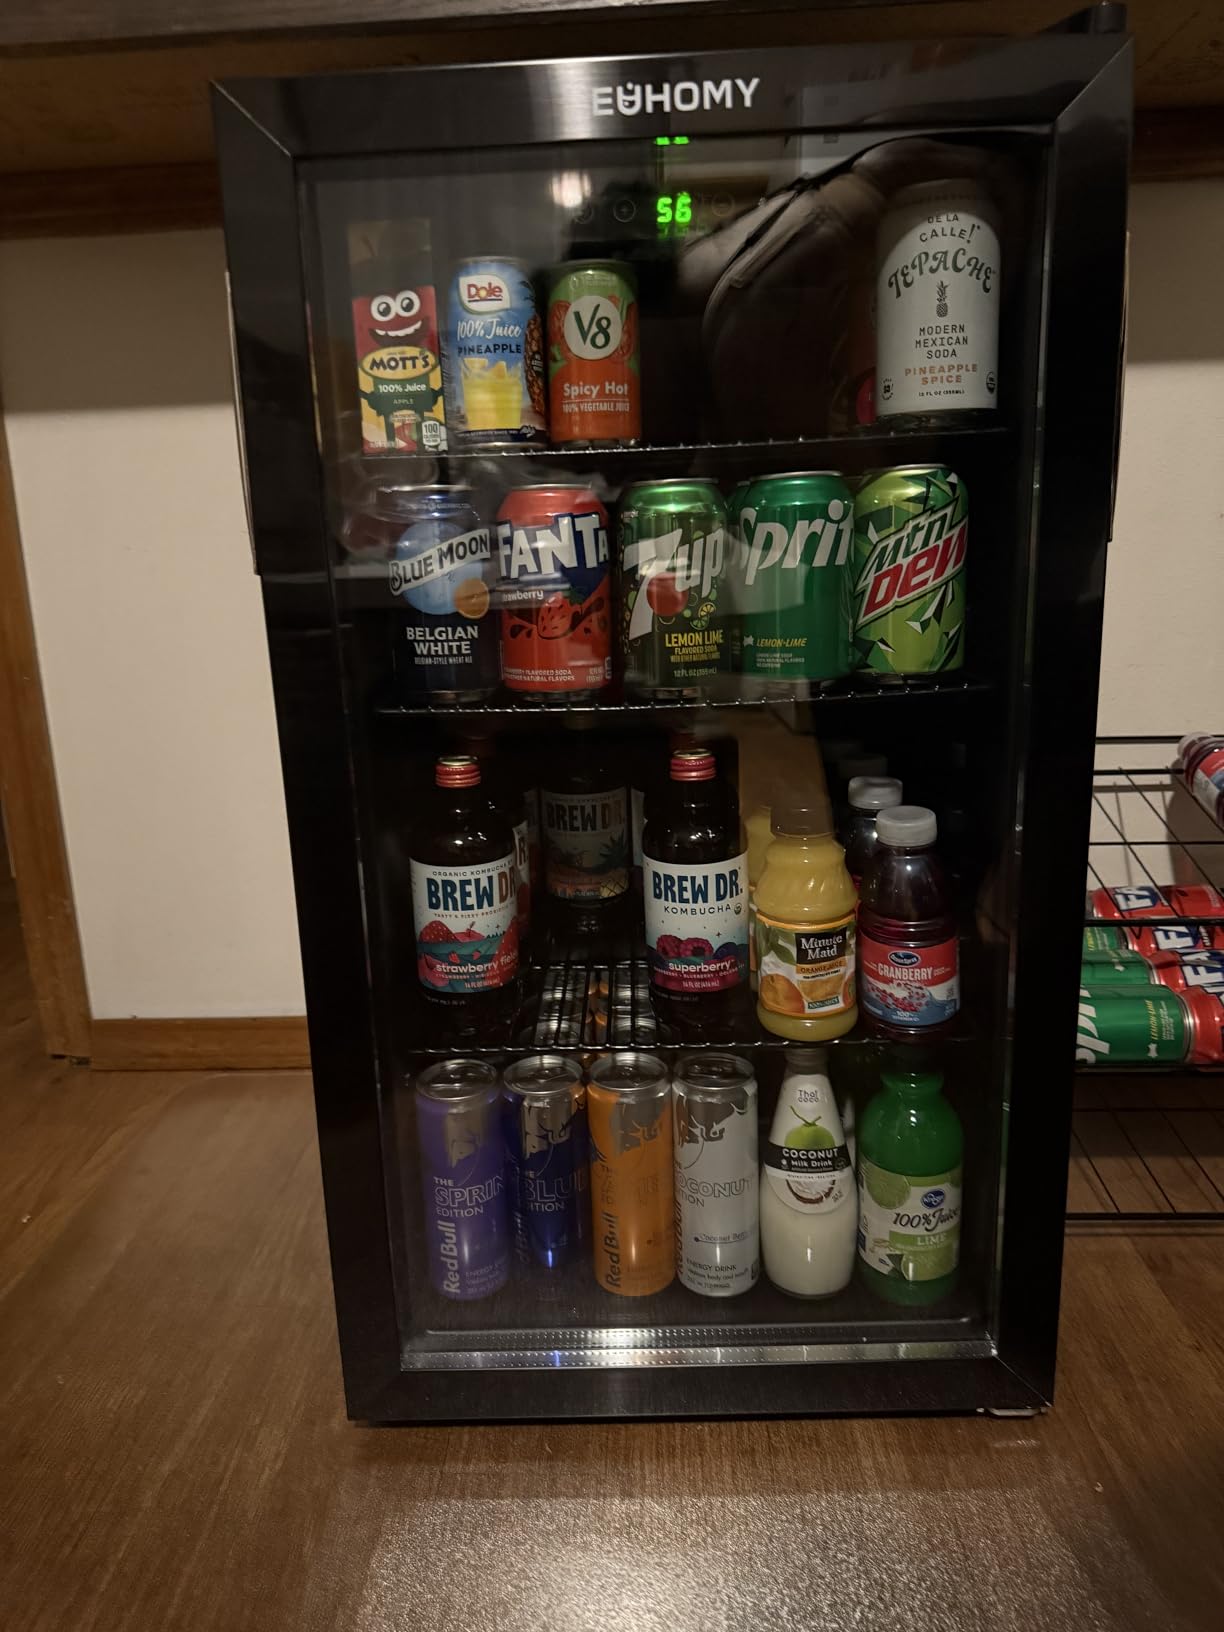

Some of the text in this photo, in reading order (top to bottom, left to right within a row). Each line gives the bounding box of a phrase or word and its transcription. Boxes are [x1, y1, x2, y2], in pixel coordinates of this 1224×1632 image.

[927, 213, 960, 224] DE LA
[919, 224, 976, 244] CALLE!
[887, 247, 993, 299] TEPACHE
[467, 282, 504, 300] Dole
[457, 317, 522, 341] 100% Juice
[572, 303, 612, 350] V8
[919, 324, 965, 336] MODERN
[457, 343, 522, 356] PINEAPPLE
[915, 336, 968, 349] MEXICAN
[926, 348, 957, 359] SODA
[369, 355, 430, 372] MOTT'S
[904, 363, 978, 377] PINEAPPLE
[378, 382, 427, 393] 100% Juice
[921, 375, 962, 386] SPICE
[563, 381, 629, 398] Spicy Hot
[580, 402, 614, 412] VEGETABLE
[423, 423, 439, 434] 100
[496, 514, 609, 579] FANTA
[390, 534, 489, 591] BLUE MOON
[405, 625, 479, 641] BELGIAN
[664, 629, 724, 648] LEMON LIME
[413, 641, 472, 656] WHITE
[756, 637, 808, 647] LEMON-LIME
[546, 801, 597, 832] BREW
[426, 875, 494, 912] BREW
[652, 868, 743, 904] BREW DR.
[663, 903, 732, 916] KOMBUCHA
[800, 934, 843, 949] Minute
[807, 945, 838, 960] Maid
[435, 959, 499, 974] strawberry
[668, 960, 732, 974] superberry
[877, 962, 933, 981] CRANBERRY
[782, 1148, 840, 1159] COCONUT
[790, 1158, 833, 1168] Milk Drink
[433, 1175, 455, 1187] THE
[680, 1189, 706, 1208] TION
[436, 1204, 484, 1218] EDITION
[529, 1201, 565, 1213] ITION
[893, 1211, 932, 1229] 100%
[916, 1232, 948, 1246] LIME
[714, 1264, 738, 1272] DRINK
